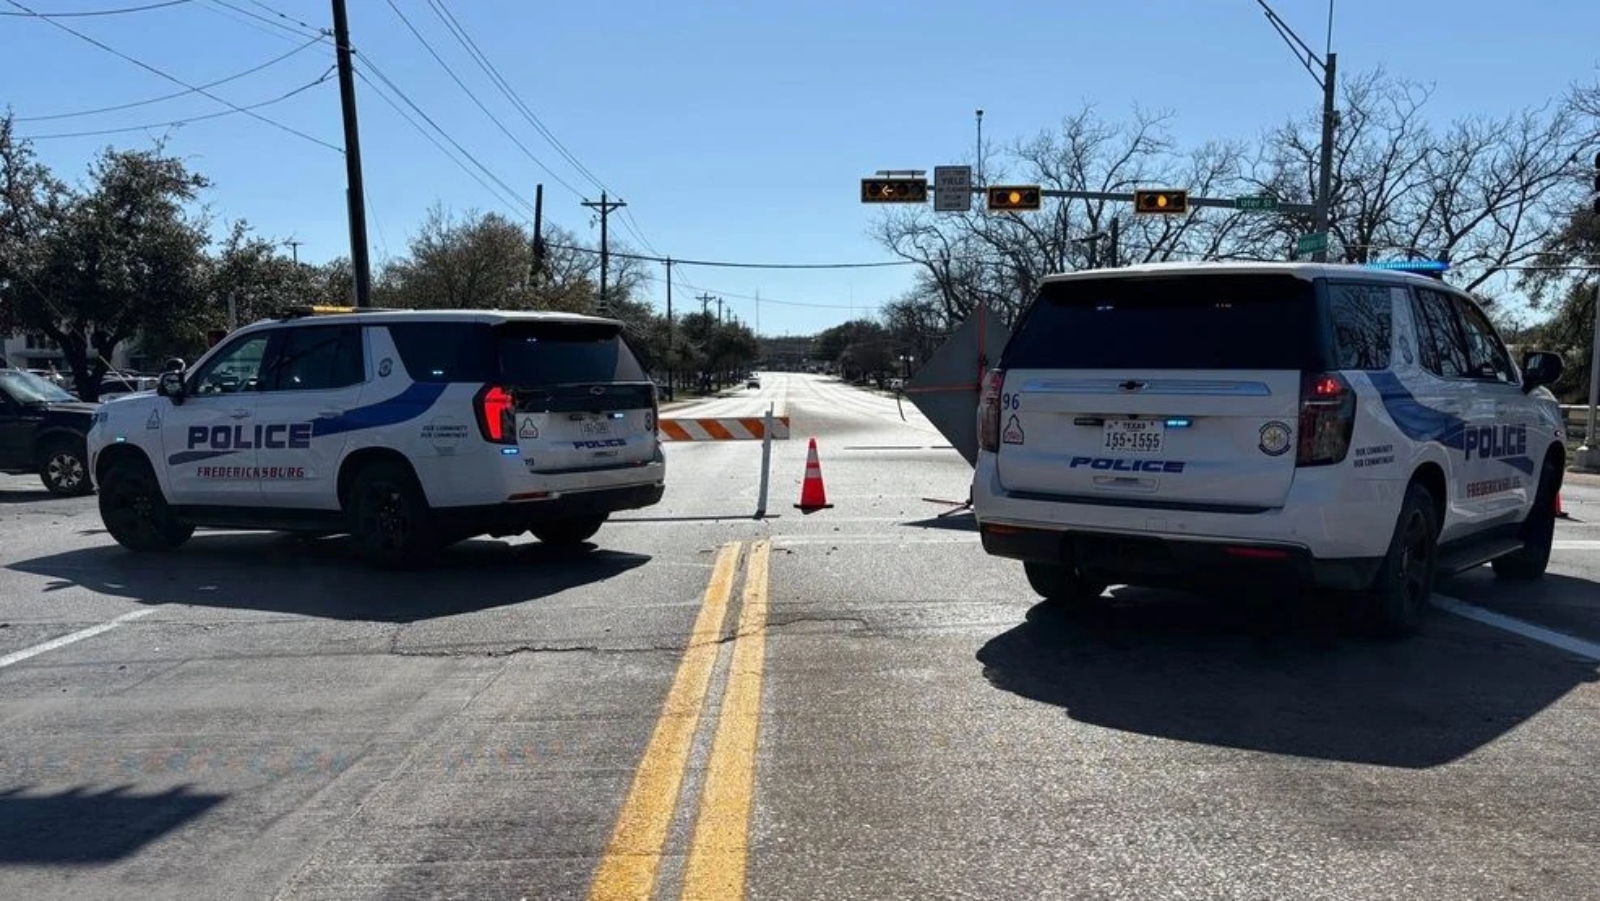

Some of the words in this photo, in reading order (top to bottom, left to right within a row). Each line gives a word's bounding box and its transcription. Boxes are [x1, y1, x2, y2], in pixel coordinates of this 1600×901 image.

[1002, 392, 1020, 410] 96
[1123, 421, 1147, 429] TEXAS
[187, 423, 312, 449] POLICE
[573, 438, 628, 449] POLICE
[1465, 424, 1527, 461] POLICE
[196, 466, 305, 478] FREDERICKSBURG
[1069, 456, 1186, 473] POLICE
